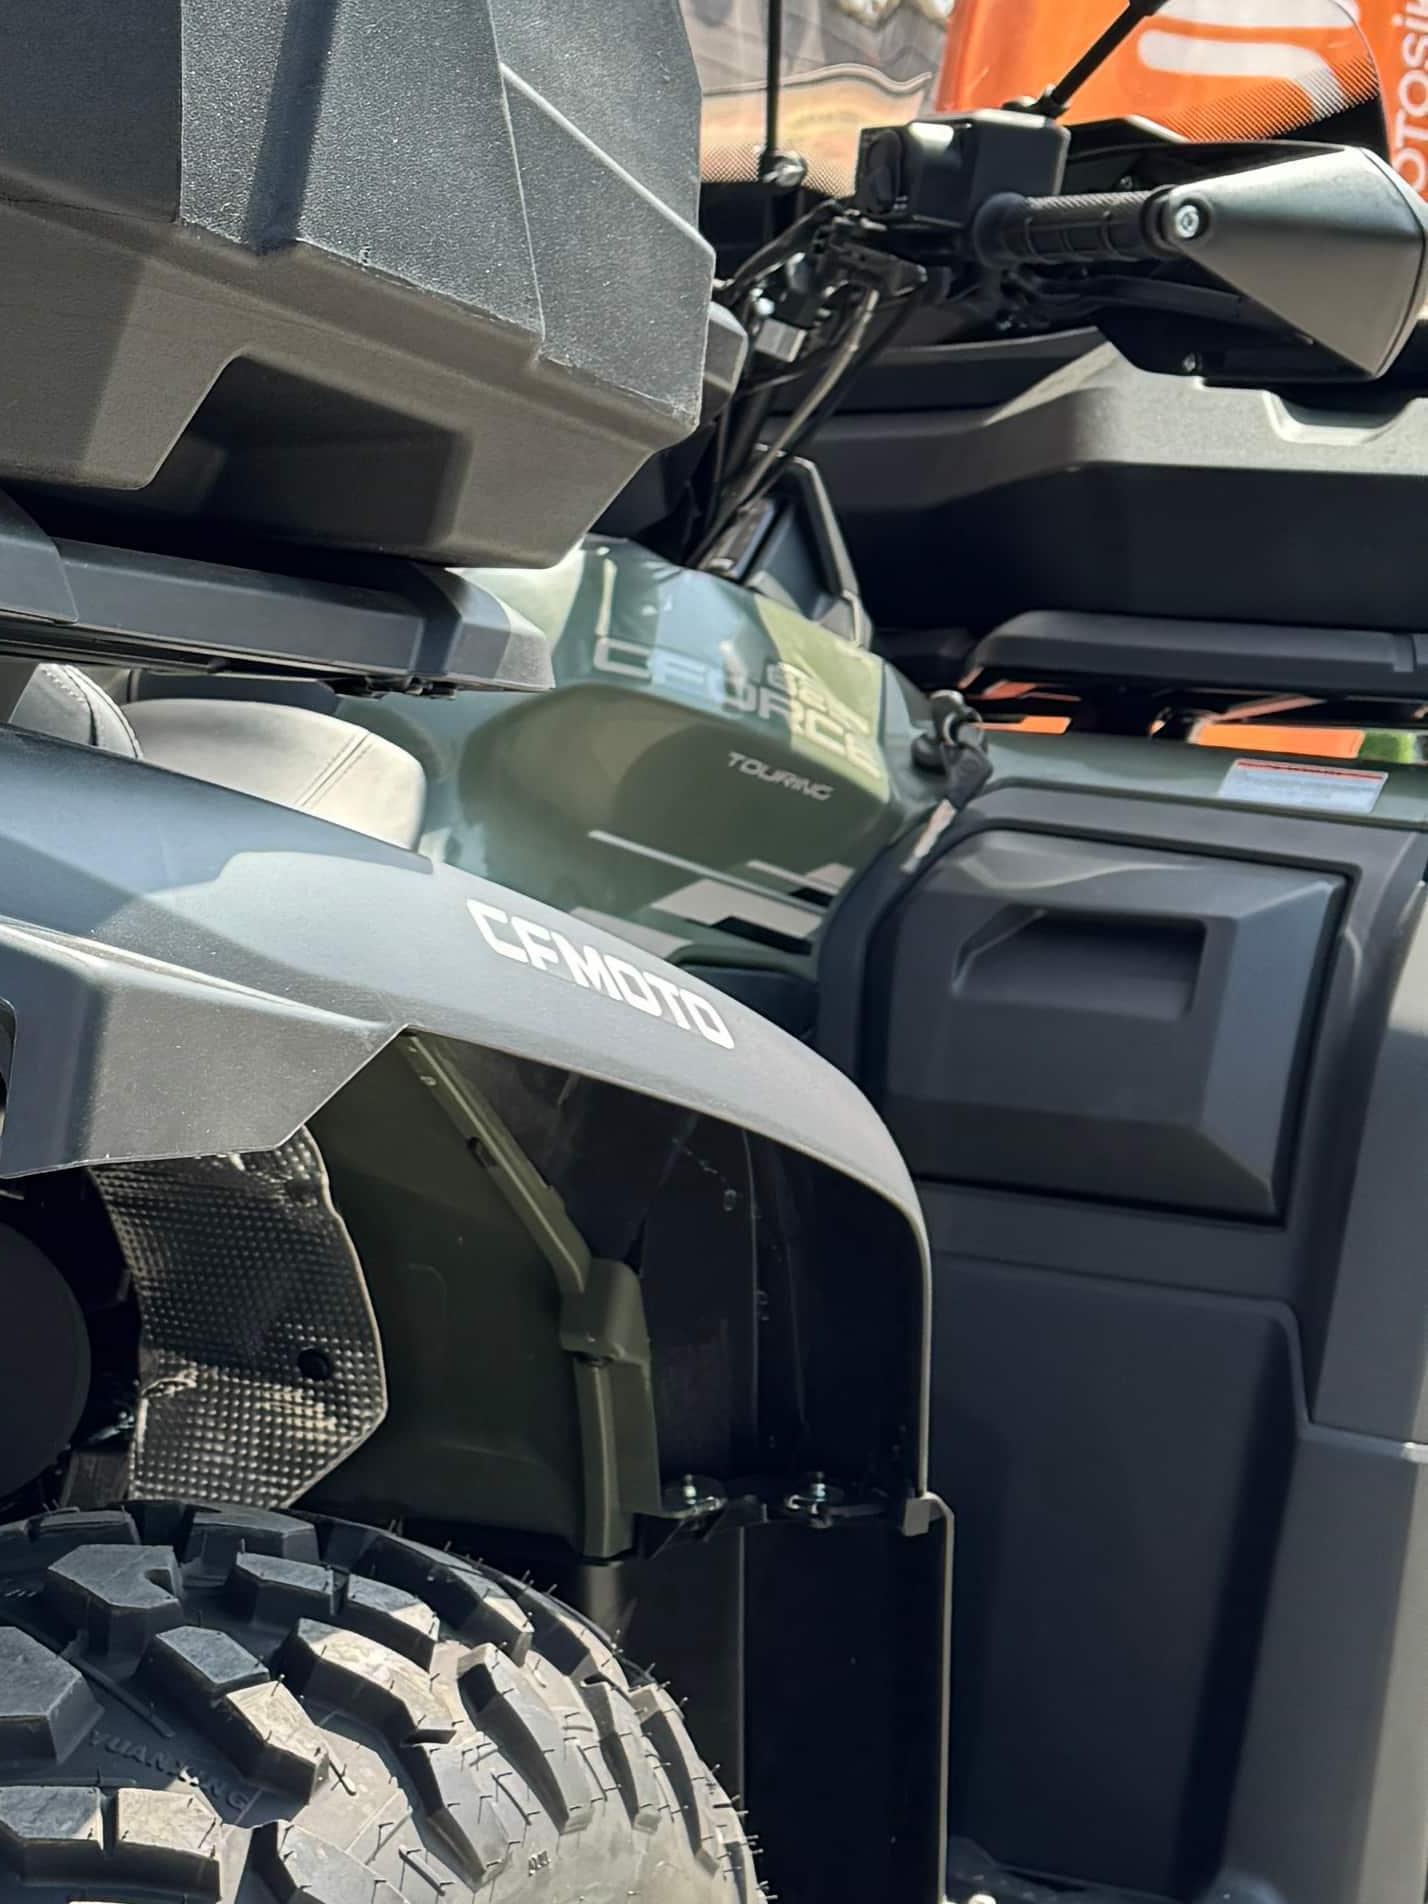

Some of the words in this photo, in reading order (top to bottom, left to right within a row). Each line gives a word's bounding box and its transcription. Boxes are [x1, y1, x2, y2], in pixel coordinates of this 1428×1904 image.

[593, 637, 881, 781] CFORCE
[728, 752, 834, 801] TOURING
[466, 898, 735, 1049] CFMOTO
